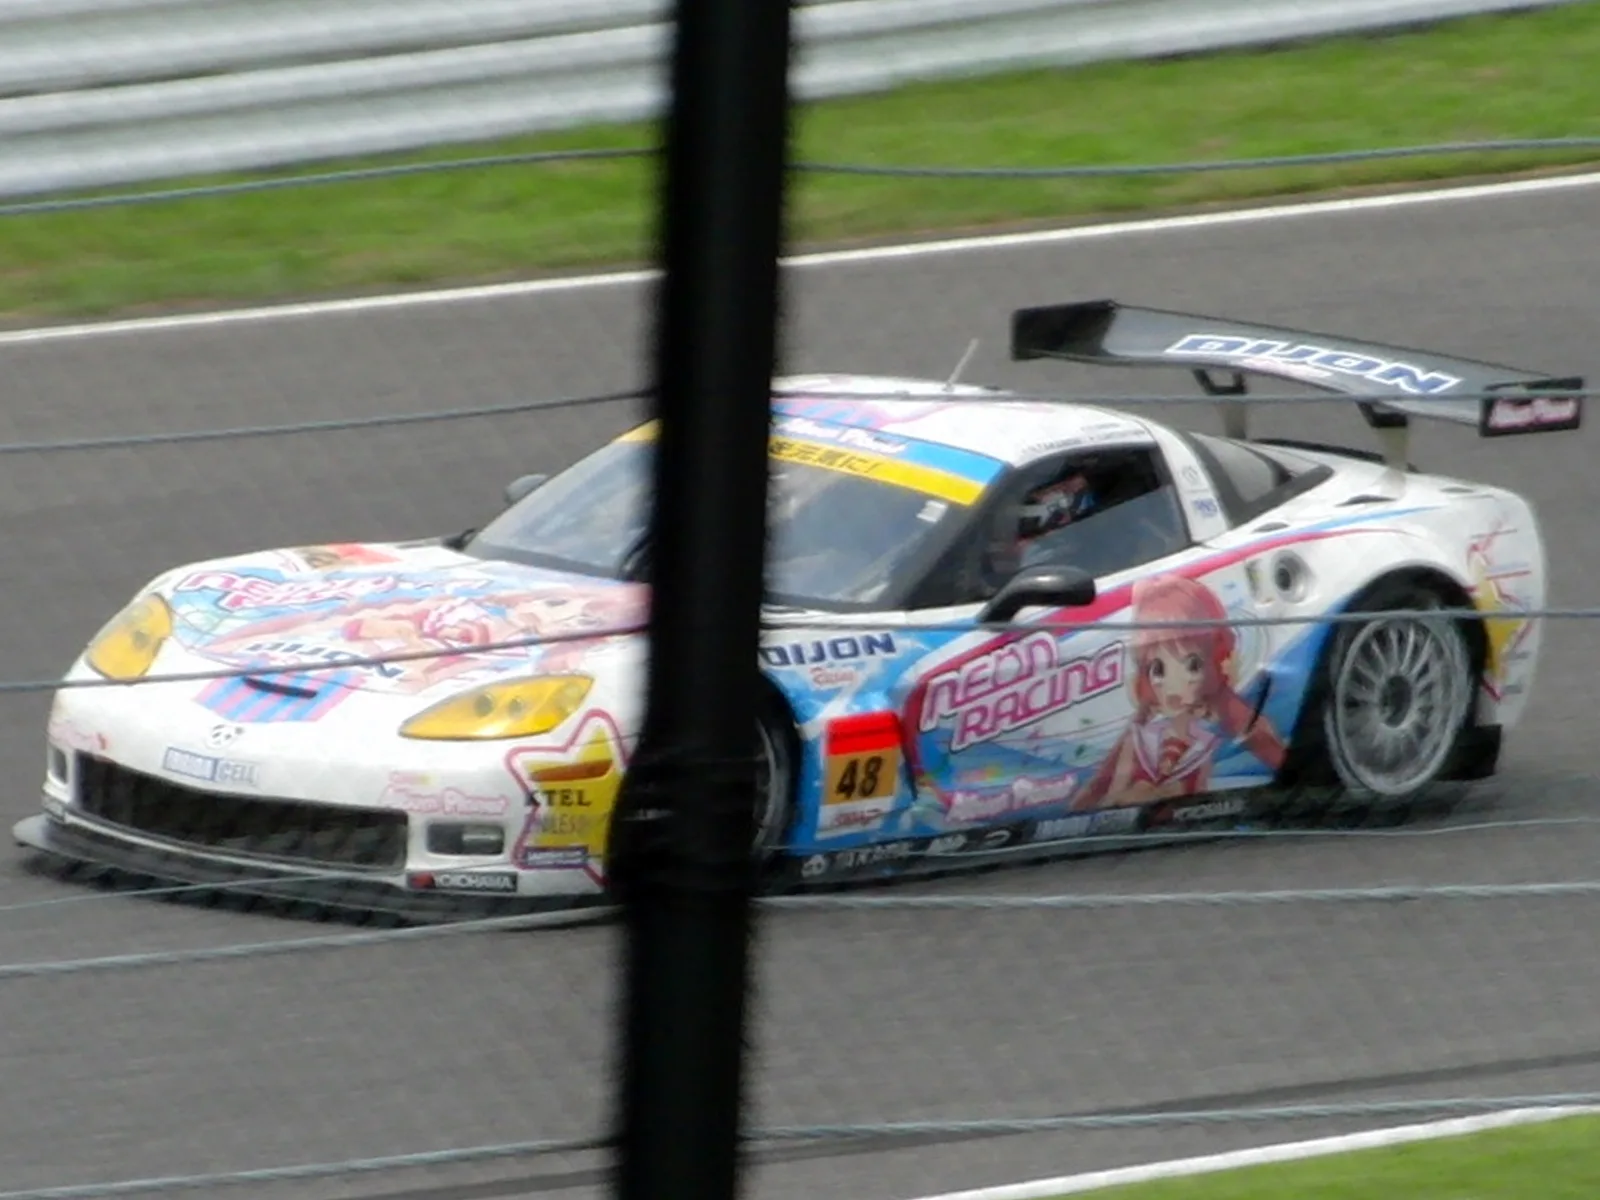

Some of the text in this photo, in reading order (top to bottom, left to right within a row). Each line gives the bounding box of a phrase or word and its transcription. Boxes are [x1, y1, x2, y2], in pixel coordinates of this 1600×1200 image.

[1164, 334, 1464, 396] DIJON
[759, 633, 897, 666] DIJON
[949, 641, 1126, 753] RACING
[834, 755, 887, 800] 48
